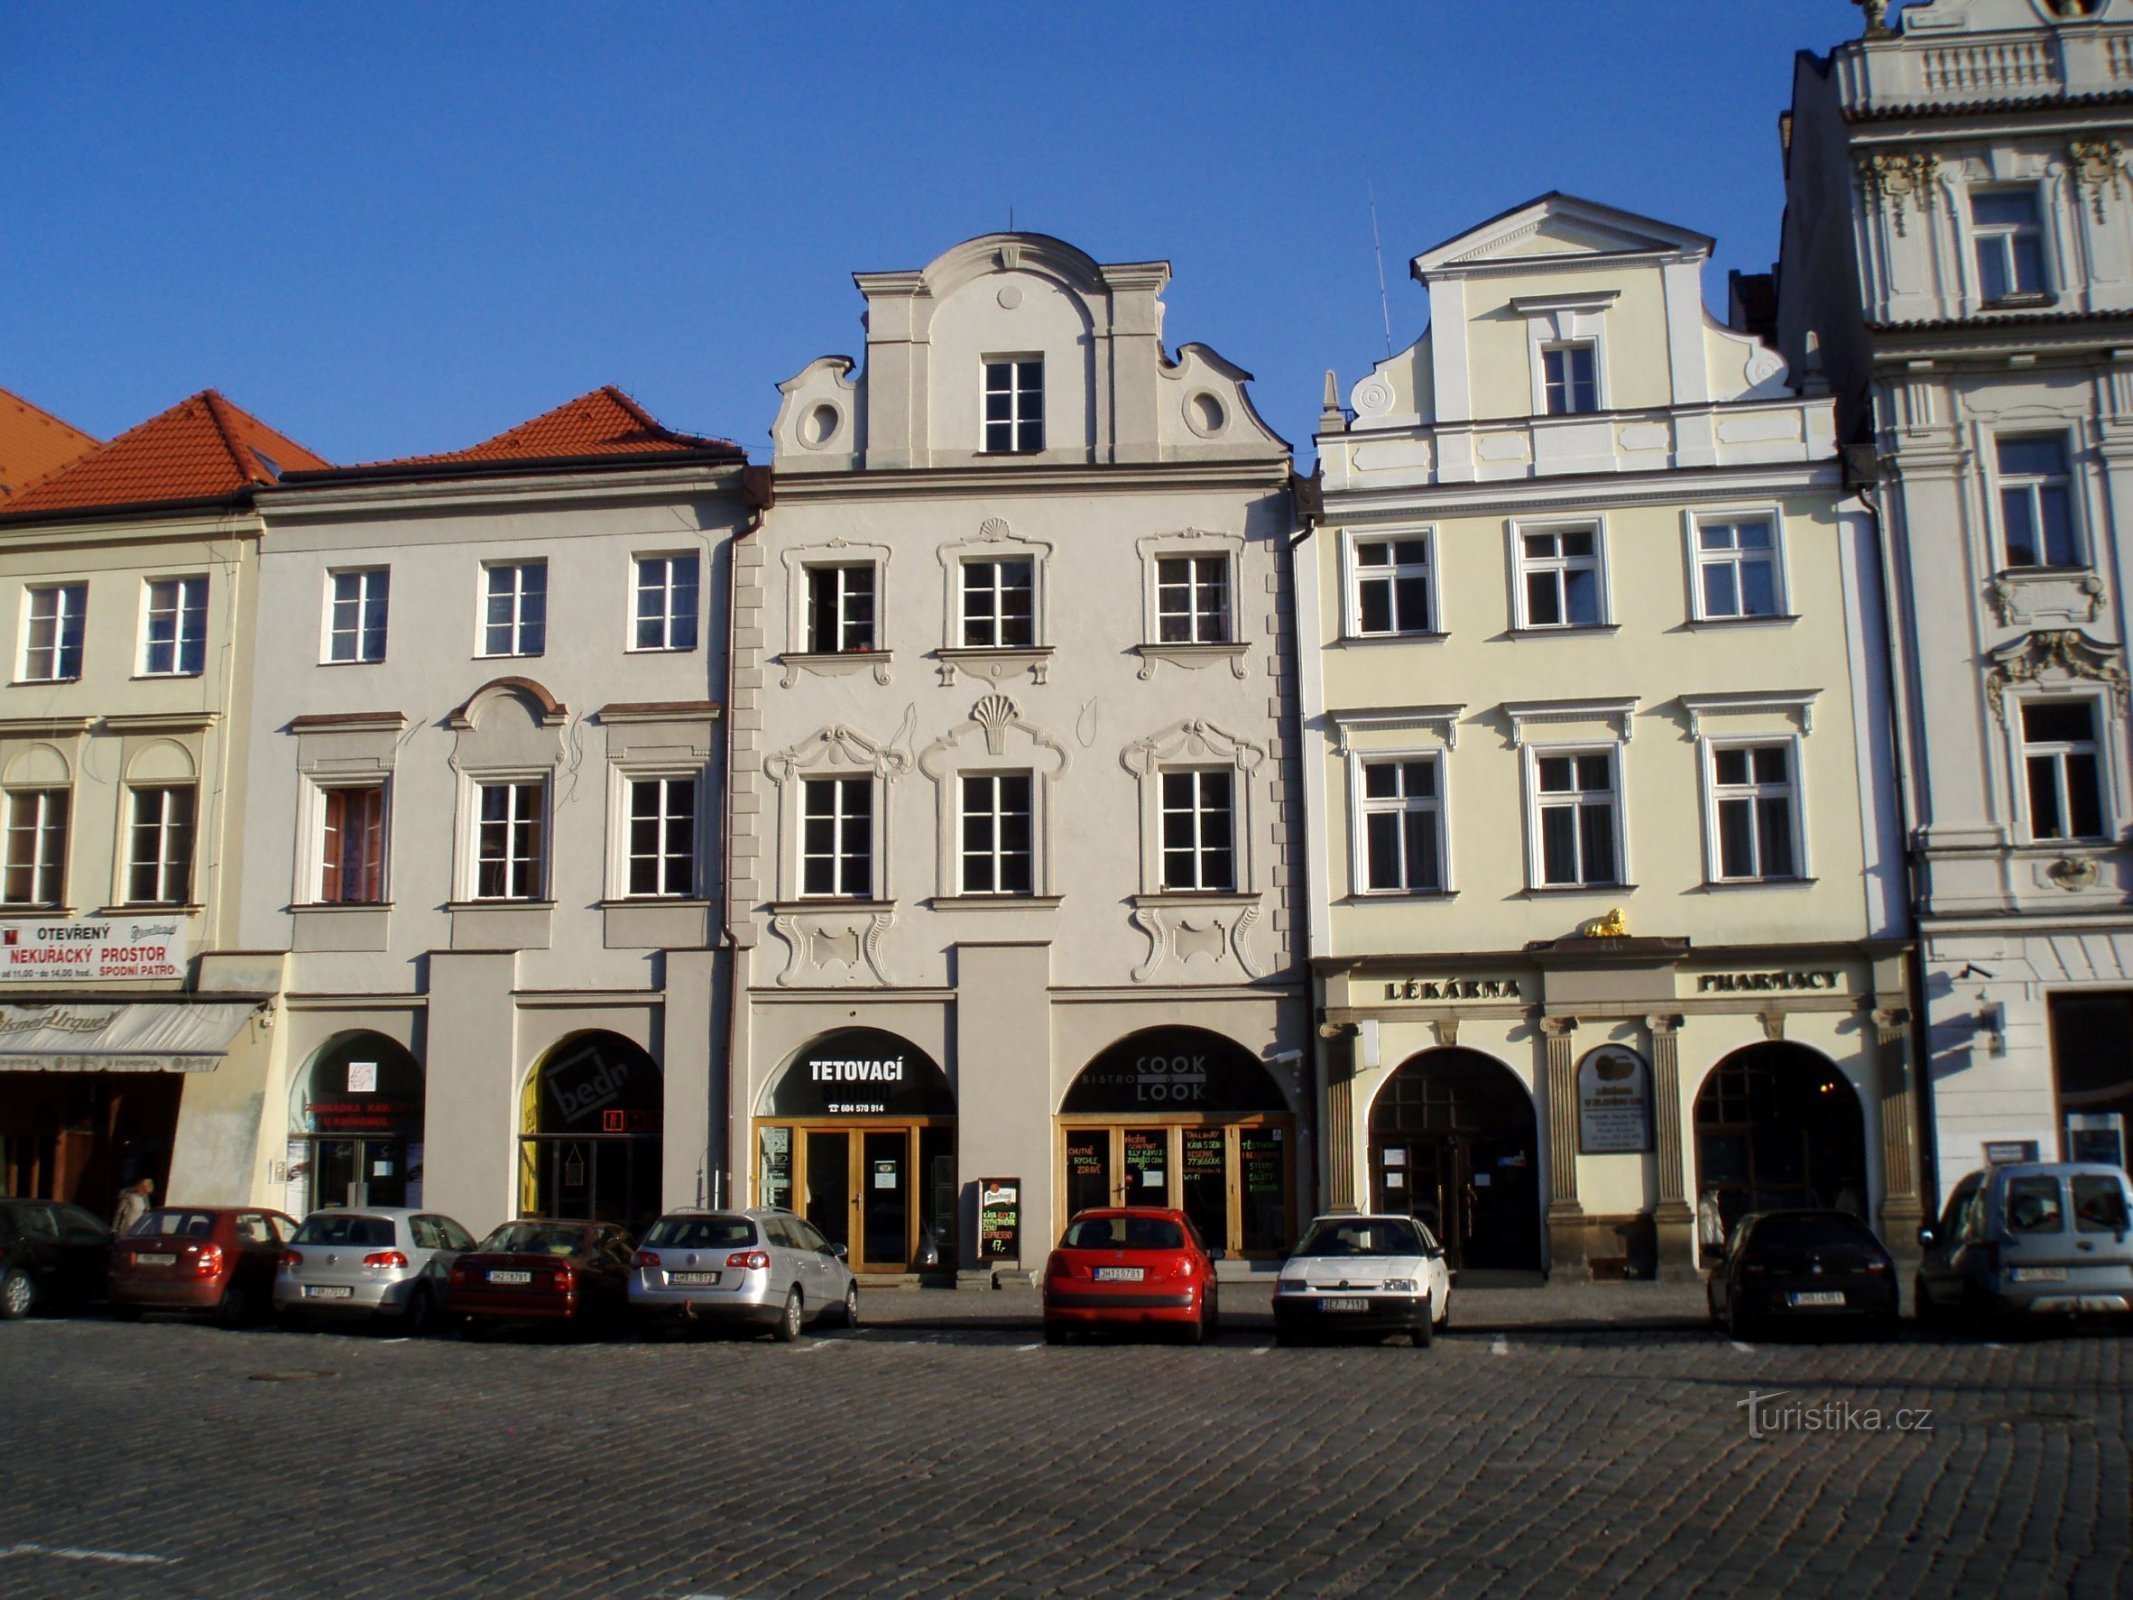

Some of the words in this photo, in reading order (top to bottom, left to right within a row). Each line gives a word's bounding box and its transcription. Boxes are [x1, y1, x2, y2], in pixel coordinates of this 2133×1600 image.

[38, 923, 111, 940] OTEVŘENÝ
[10, 944, 94, 963] NEKUŘÁCKÝ
[101, 947, 166, 962] PROSTOR
[100, 964, 139, 976] SPODNÍ
[141, 965, 176, 975] PATRO
[1385, 977, 1520, 1000] LÉKÁRNA
[1697, 971, 1840, 992] PHARMACY
[809, 1056, 904, 1081] TETOVACÍ
[1136, 1056, 1206, 1074] COOK
[1082, 1074, 1137, 1085] BISTRO
[823, 1083, 890, 1102] STUDIO
[1136, 1083, 1205, 1101] LOOK
[871, 1104, 884, 1113] 914
